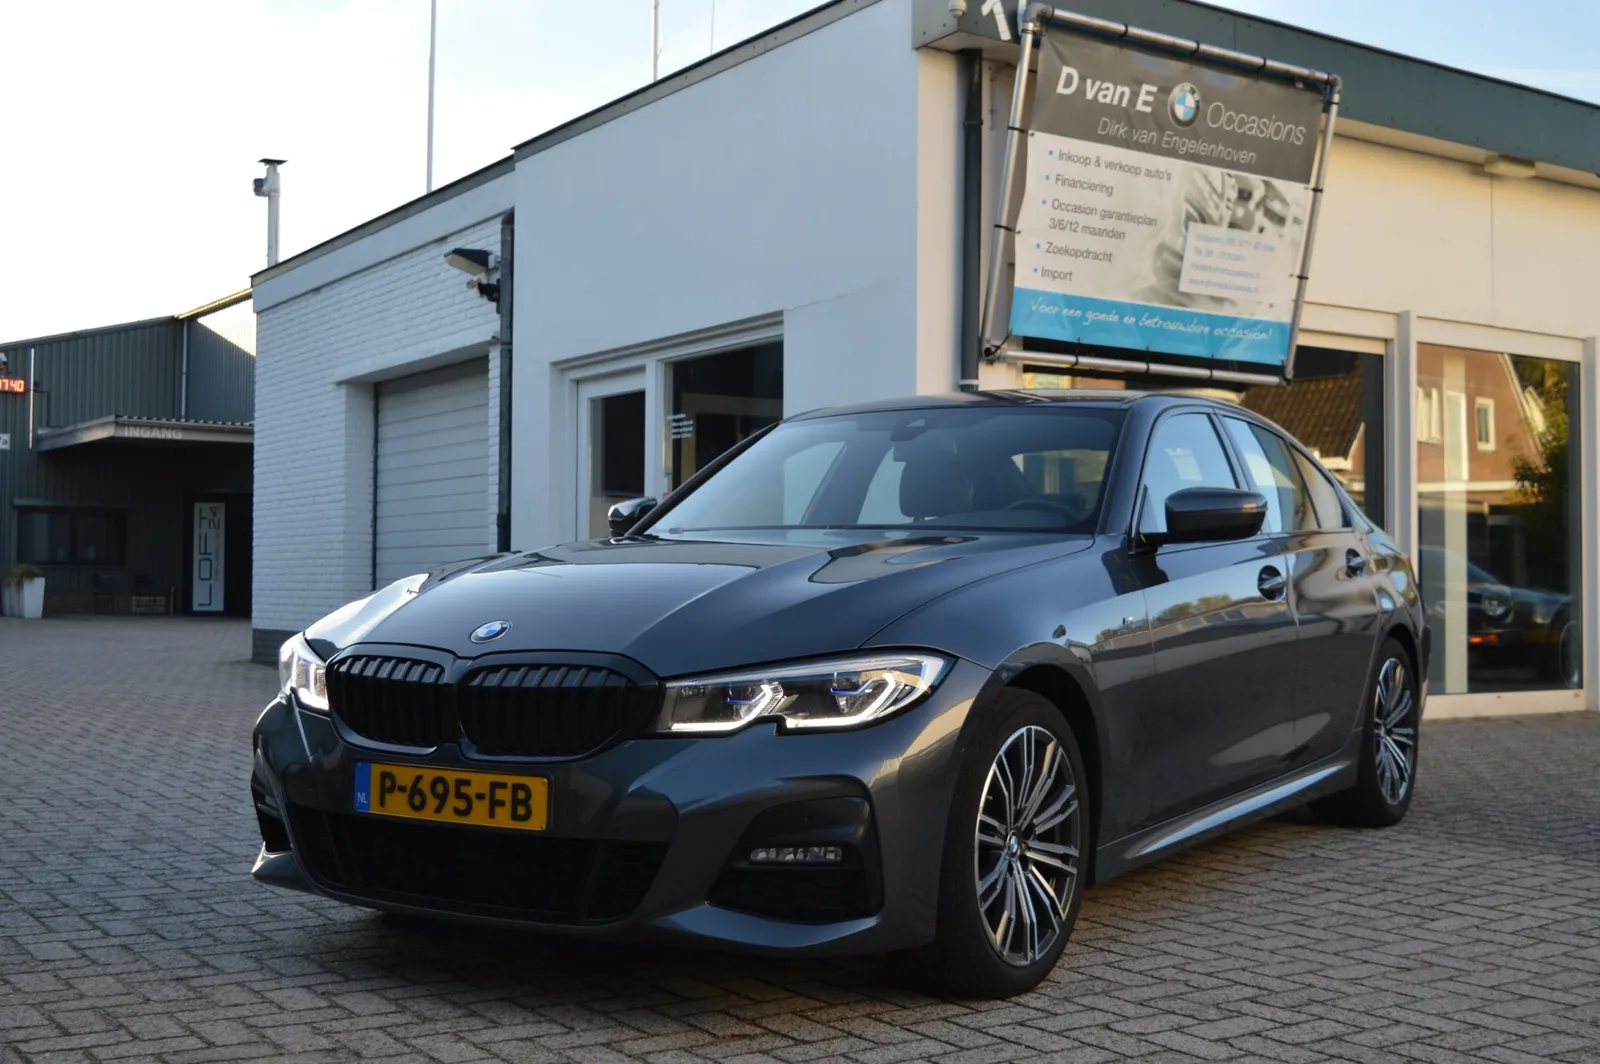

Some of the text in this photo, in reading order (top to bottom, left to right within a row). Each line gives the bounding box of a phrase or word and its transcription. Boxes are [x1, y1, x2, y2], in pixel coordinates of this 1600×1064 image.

[1055, 65, 1080, 95] D
[1085, 77, 1131, 108] van
[1135, 83, 1158, 113] E
[1206, 101, 1307, 146] Occasions
[1097, 116, 1257, 166] Dirk van Engelenhoven
[1058, 149, 1172, 181] Inkoop & verkoop auto's
[1054, 173, 1114, 198] Financiering
[1051, 198, 1158, 227] Occasion garantieplan
[1048, 217, 1126, 240] 3/6/12 maanden
[1045, 241, 1113, 263] Zoekopdracht
[1041, 266, 1074, 282] Import
[1031, 296, 1273, 341] Voor een goede en betrouwbare occasion!
[124, 426, 183, 439] INGANG
[198, 507, 213, 607] LOFT
[357, 791, 369, 804] NL
[379, 770, 533, 823] P-695-FB
